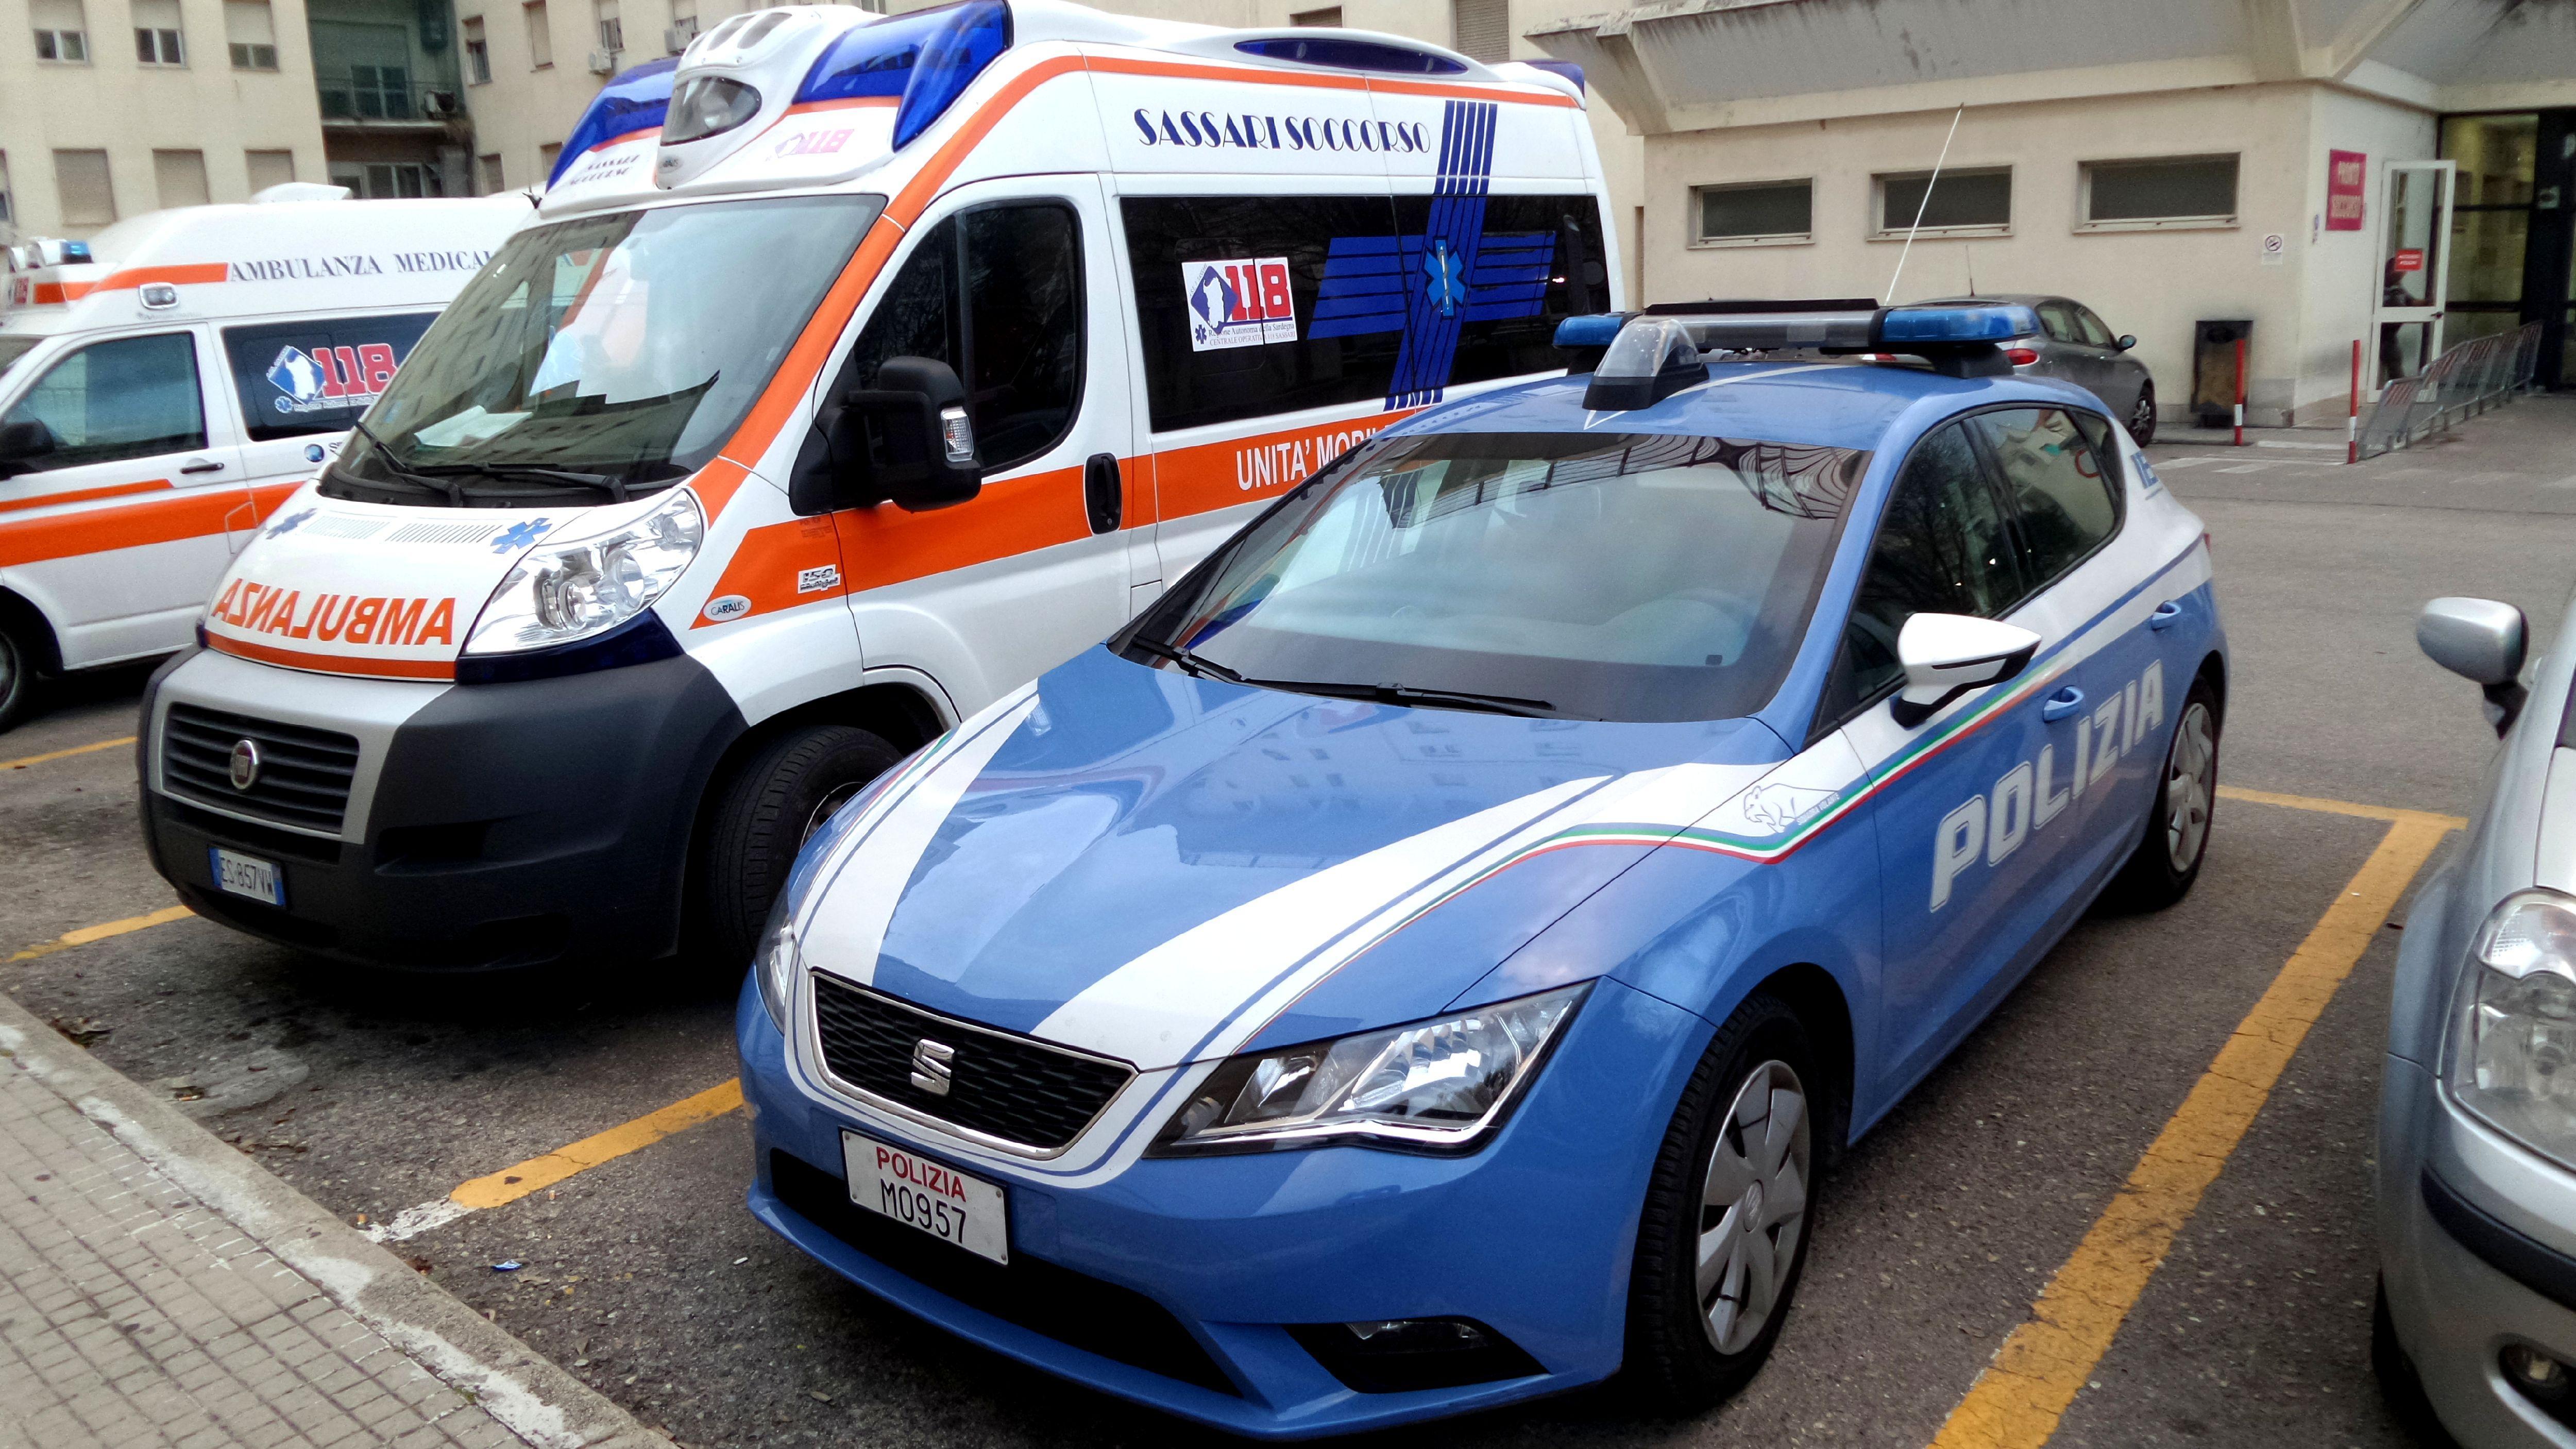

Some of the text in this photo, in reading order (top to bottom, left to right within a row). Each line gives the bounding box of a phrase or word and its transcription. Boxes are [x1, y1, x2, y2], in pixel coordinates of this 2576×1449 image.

[1133, 108, 1431, 154] SASSARI SOCCORSO
[230, 255, 383, 282] AMBULANZA
[1225, 264, 1292, 321] 118
[1210, 336, 1237, 346] CENTRALE
[1232, 327, 1258, 335] Autonoma
[1273, 323, 1294, 331] Sardegna
[312, 343, 399, 398] 118
[1236, 438, 1311, 491] UNITA'
[803, 568, 833, 583] 150
[710, 601, 745, 616] CARALIS
[1929, 659, 2164, 914] POLIZIA
[875, 1146, 967, 1202] POLIZIA
[880, 1177, 967, 1244] M0957
